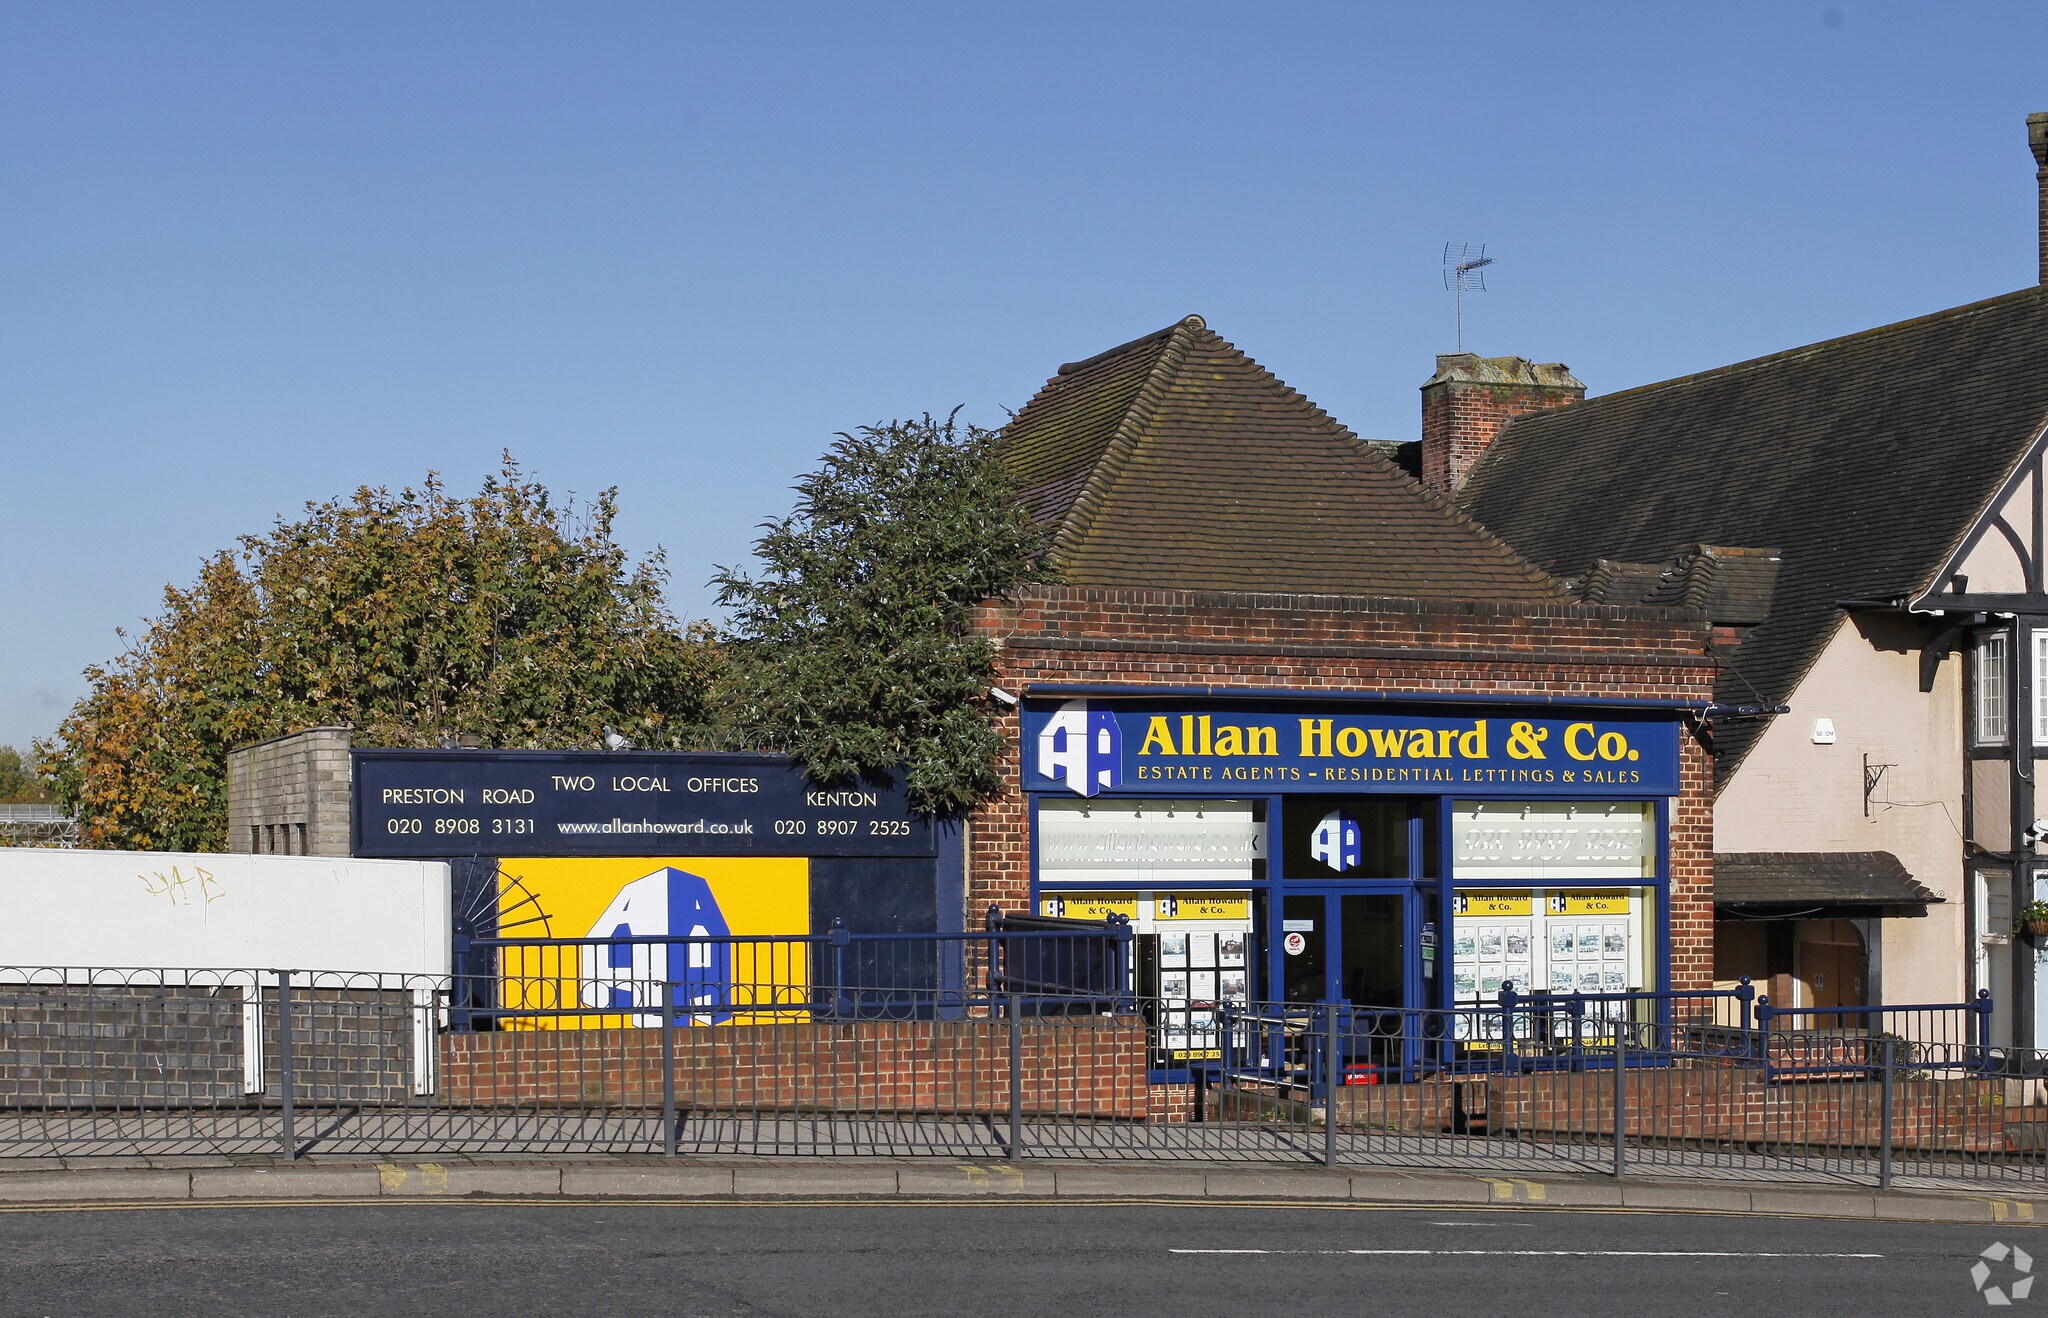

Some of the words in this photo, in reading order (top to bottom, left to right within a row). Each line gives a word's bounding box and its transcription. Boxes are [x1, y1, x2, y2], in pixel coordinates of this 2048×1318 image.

[1138, 715, 1279, 756] Allan
[1299, 719, 1489, 758] Howard
[1507, 722, 1548, 759] &
[1564, 723, 1639, 761] Co.
[1139, 766, 1212, 779] ESTATE
[1222, 767, 1300, 780] AGENTS
[1326, 768, 1453, 781] RESIDENTIAL
[1463, 769, 1554, 782] LETTINGS
[1563, 770, 1575, 782] &
[1584, 770, 1639, 782] SALES
[552, 776, 595, 791] TWO
[613, 777, 670, 791] LOCAL
[688, 778, 758, 792] OFFICES
[383, 789, 463, 804] PRESTON
[483, 789, 534, 804] ROAD
[807, 792, 876, 806] KENTON
[388, 819, 422, 834] 020
[435, 819, 479, 834] 8908
[493, 819, 533, 834] 3131
[557, 818, 754, 834] www.allanhoward.co.uk
[775, 820, 805, 834] 020
[818, 821, 857, 835] 8907
[870, 821, 909, 835] 2525
[1070, 897, 1094, 905] Allan
[1097, 896, 1133, 905] Howard
[1182, 896, 1206, 905] Allan
[1208, 896, 1243, 905] Howard
[1472, 894, 1494, 902] Allan
[1496, 893, 1528, 902] Howard
[1571, 893, 1591, 901] Allan
[1593, 892, 1625, 901] Howard
[1210, 906, 1226, 914] Co.
